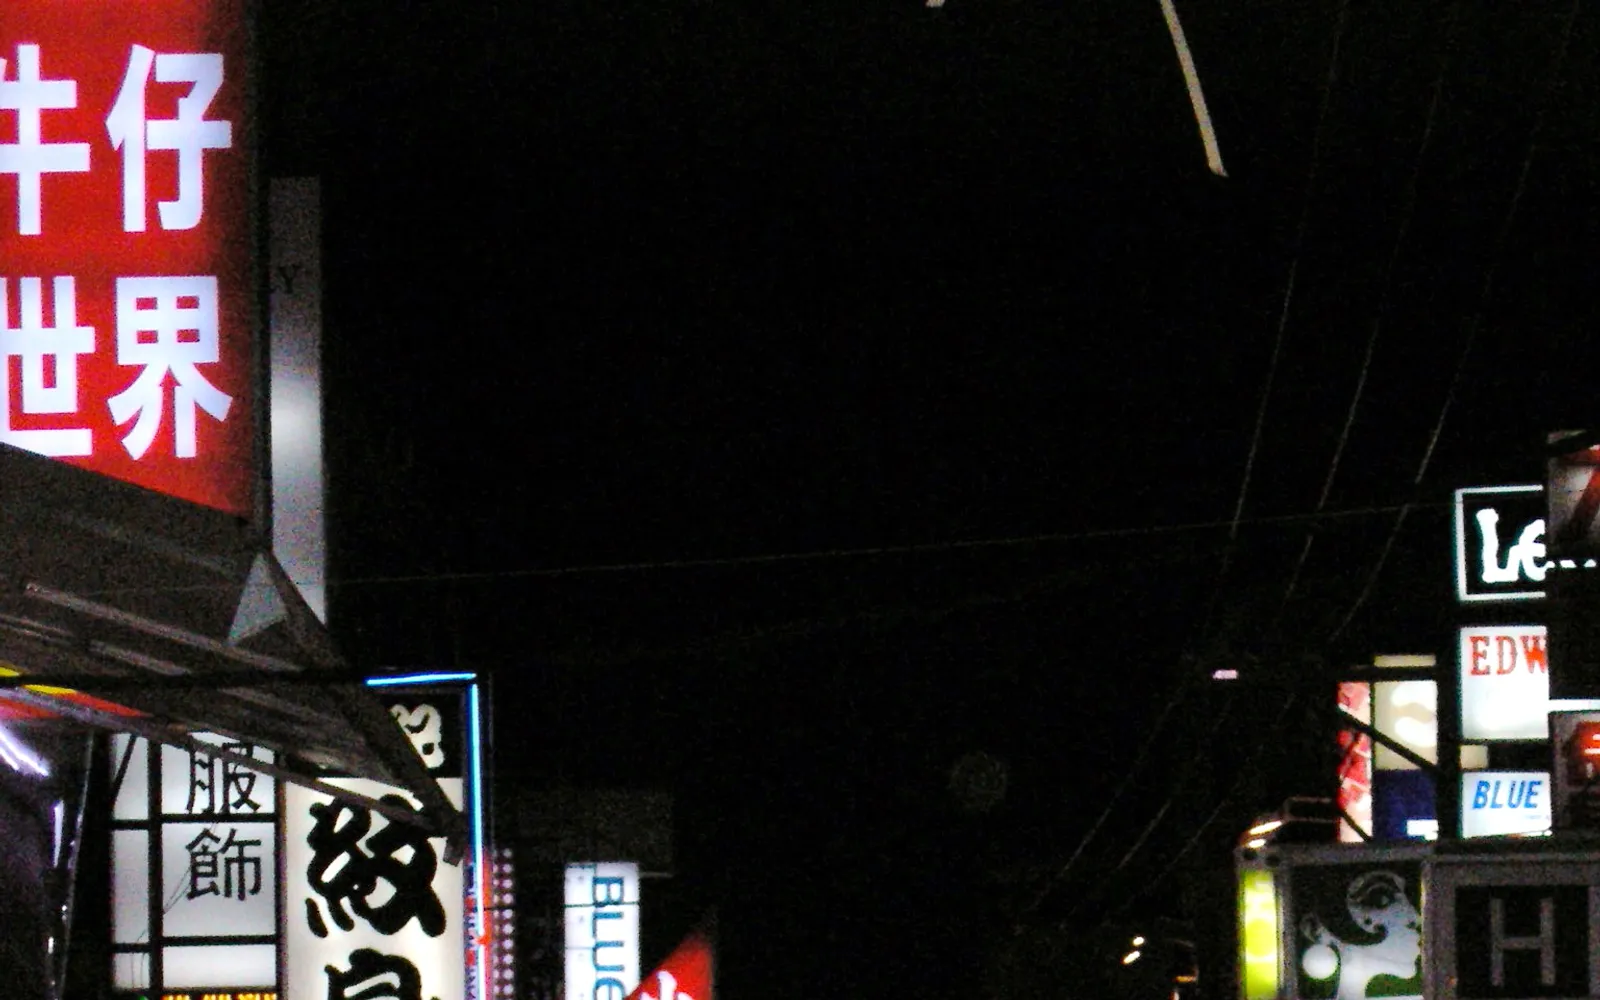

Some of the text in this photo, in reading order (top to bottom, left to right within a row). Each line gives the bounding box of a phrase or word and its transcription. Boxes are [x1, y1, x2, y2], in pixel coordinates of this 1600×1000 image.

[0, 44, 232, 235] 牛仔
[0, 276, 232, 460] 世界
[185, 733, 261, 901] 服飾
[1472, 780, 1542, 810] BLUE
